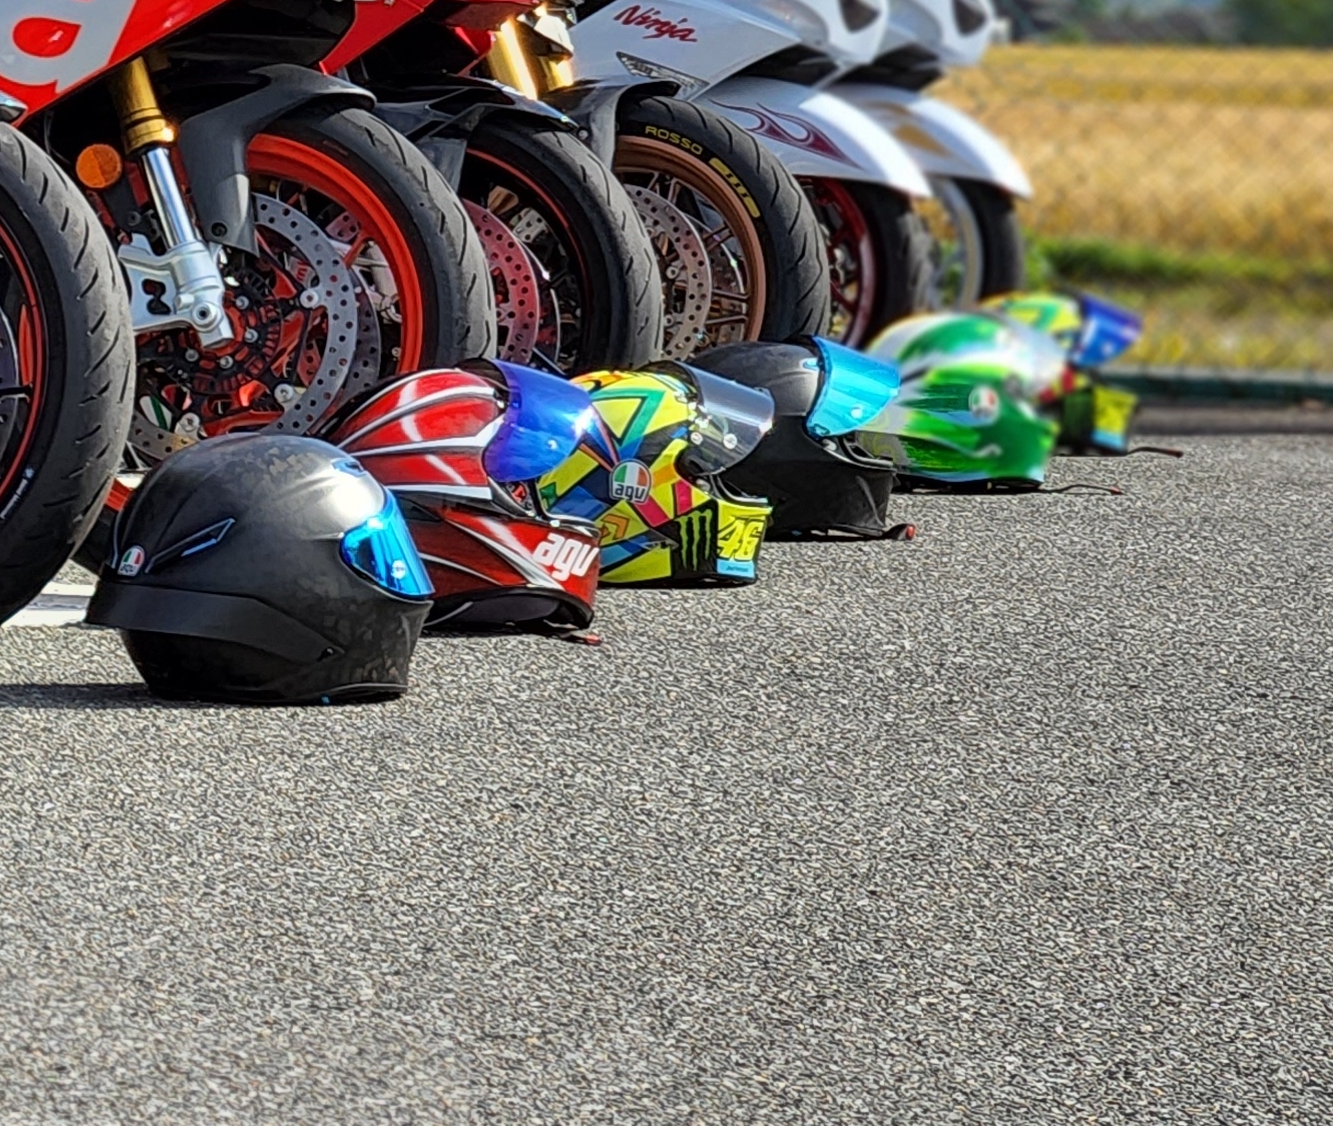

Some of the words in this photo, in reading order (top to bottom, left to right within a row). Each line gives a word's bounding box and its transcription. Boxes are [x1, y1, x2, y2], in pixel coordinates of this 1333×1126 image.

[613, 4, 699, 43] Ninja
[645, 125, 703, 155] ROSSO
[614, 483, 646, 501] agv
[532, 532, 600, 582] agv
[717, 519, 764, 561] 46
